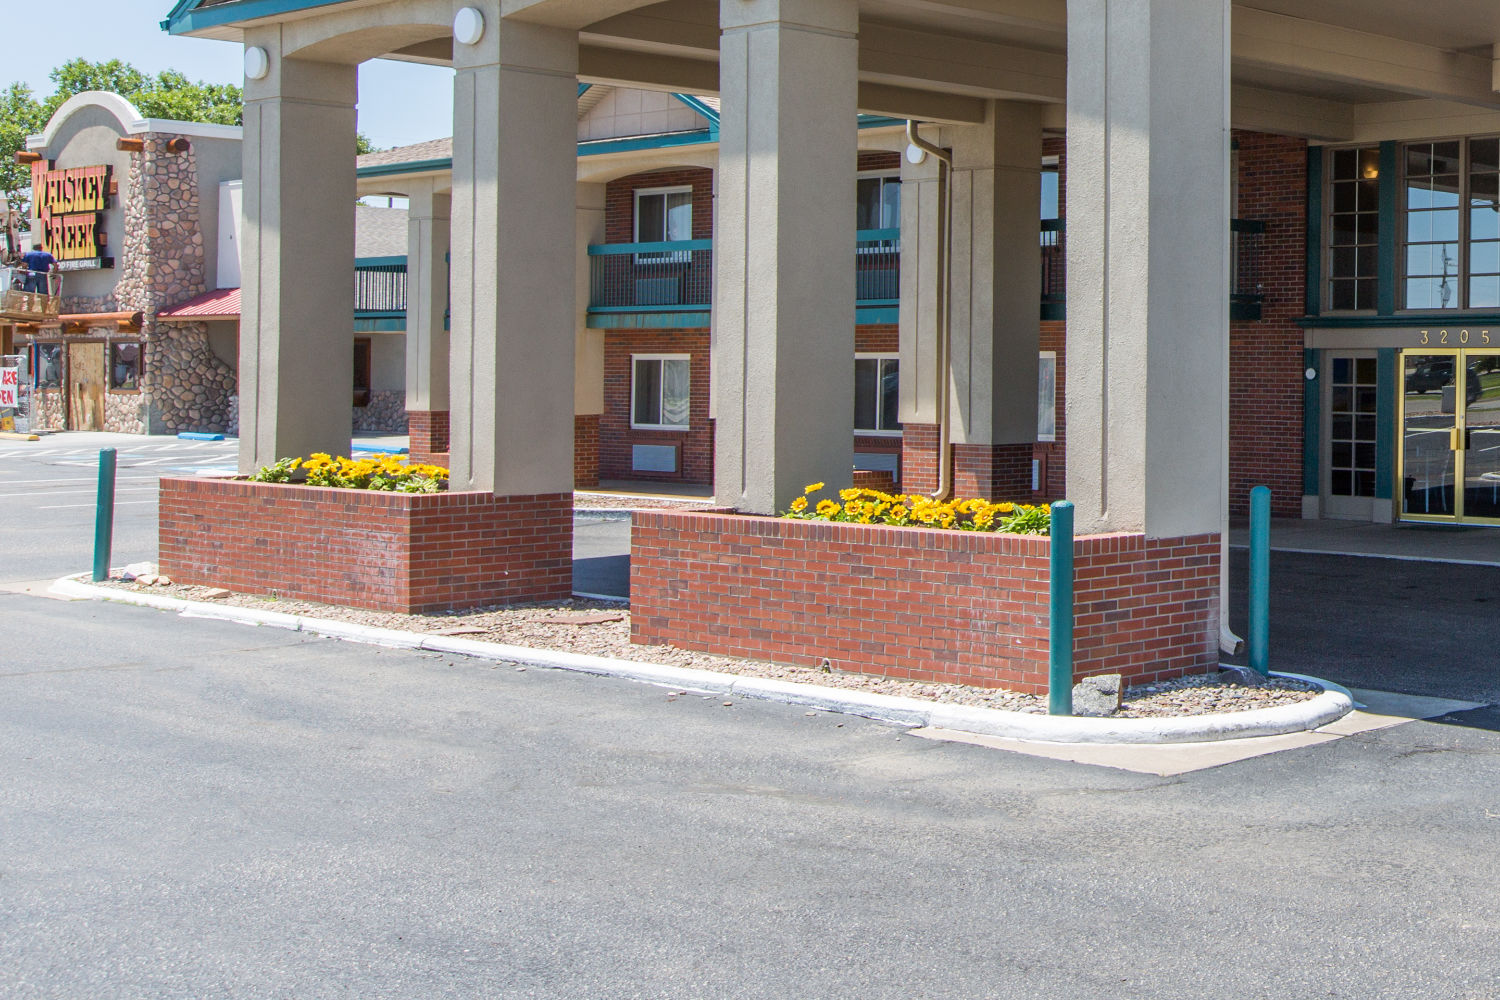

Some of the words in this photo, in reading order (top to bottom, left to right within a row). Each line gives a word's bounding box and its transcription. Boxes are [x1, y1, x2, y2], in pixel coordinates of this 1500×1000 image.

[32, 160, 107, 218] WHISKEY
[41, 205, 97, 260] CREEK
[79, 259, 97, 268] GRILL
[0, 390, 13, 405] EN
